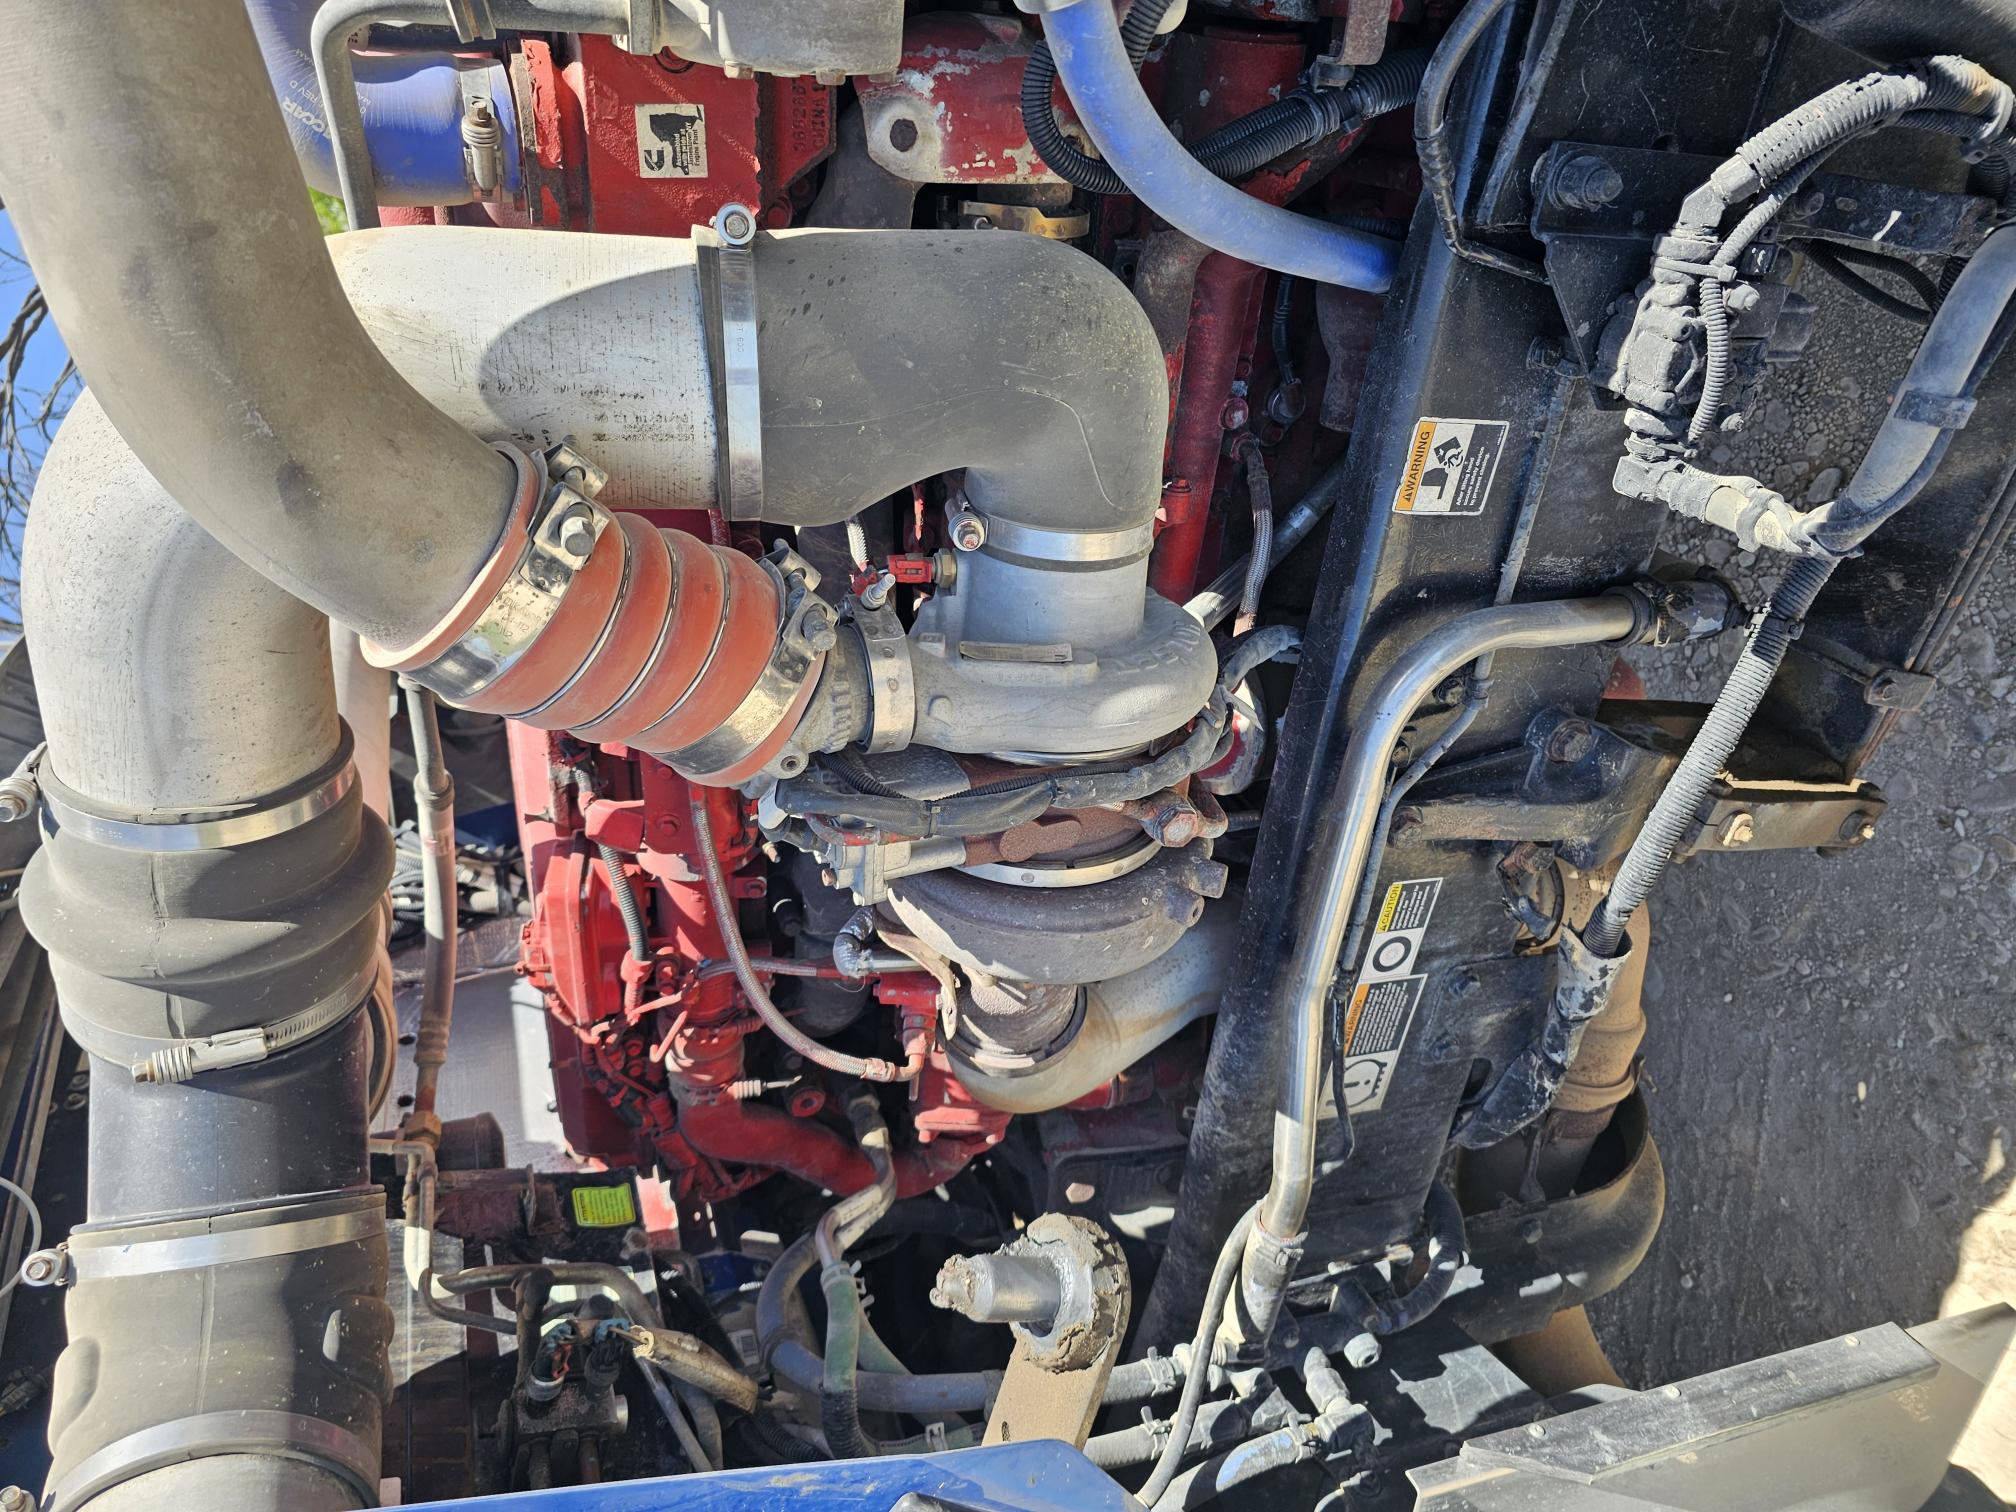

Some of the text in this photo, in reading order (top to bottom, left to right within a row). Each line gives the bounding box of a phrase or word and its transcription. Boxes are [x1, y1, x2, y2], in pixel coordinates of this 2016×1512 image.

[673, 133, 682, 166] Assembled
[686, 131, 694, 166] Jamestown
[693, 146, 701, 166] Engine
[1405, 431, 1431, 493] WARNING
[1456, 491, 1464, 505] After
[1382, 885, 1400, 925] CAUTION
